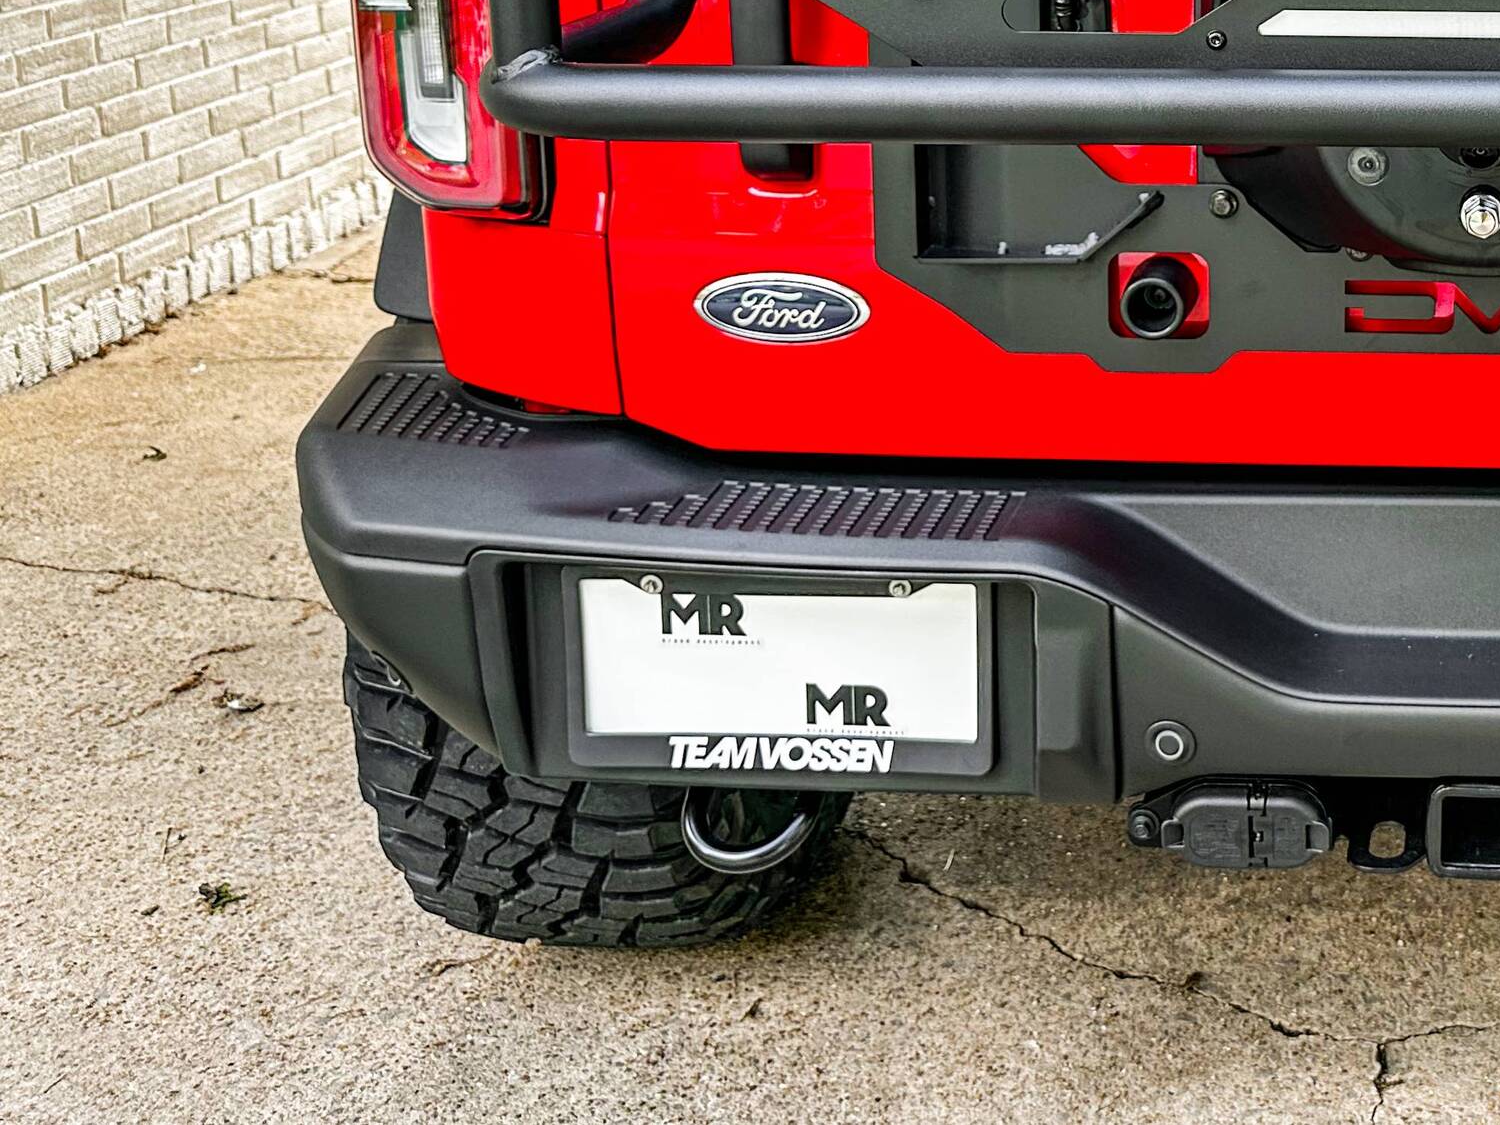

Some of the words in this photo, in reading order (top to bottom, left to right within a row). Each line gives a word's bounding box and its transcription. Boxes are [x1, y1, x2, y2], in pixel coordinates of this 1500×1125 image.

[732, 288, 827, 329] Ford
[661, 593, 747, 636] MR
[806, 683, 891, 727] MR
